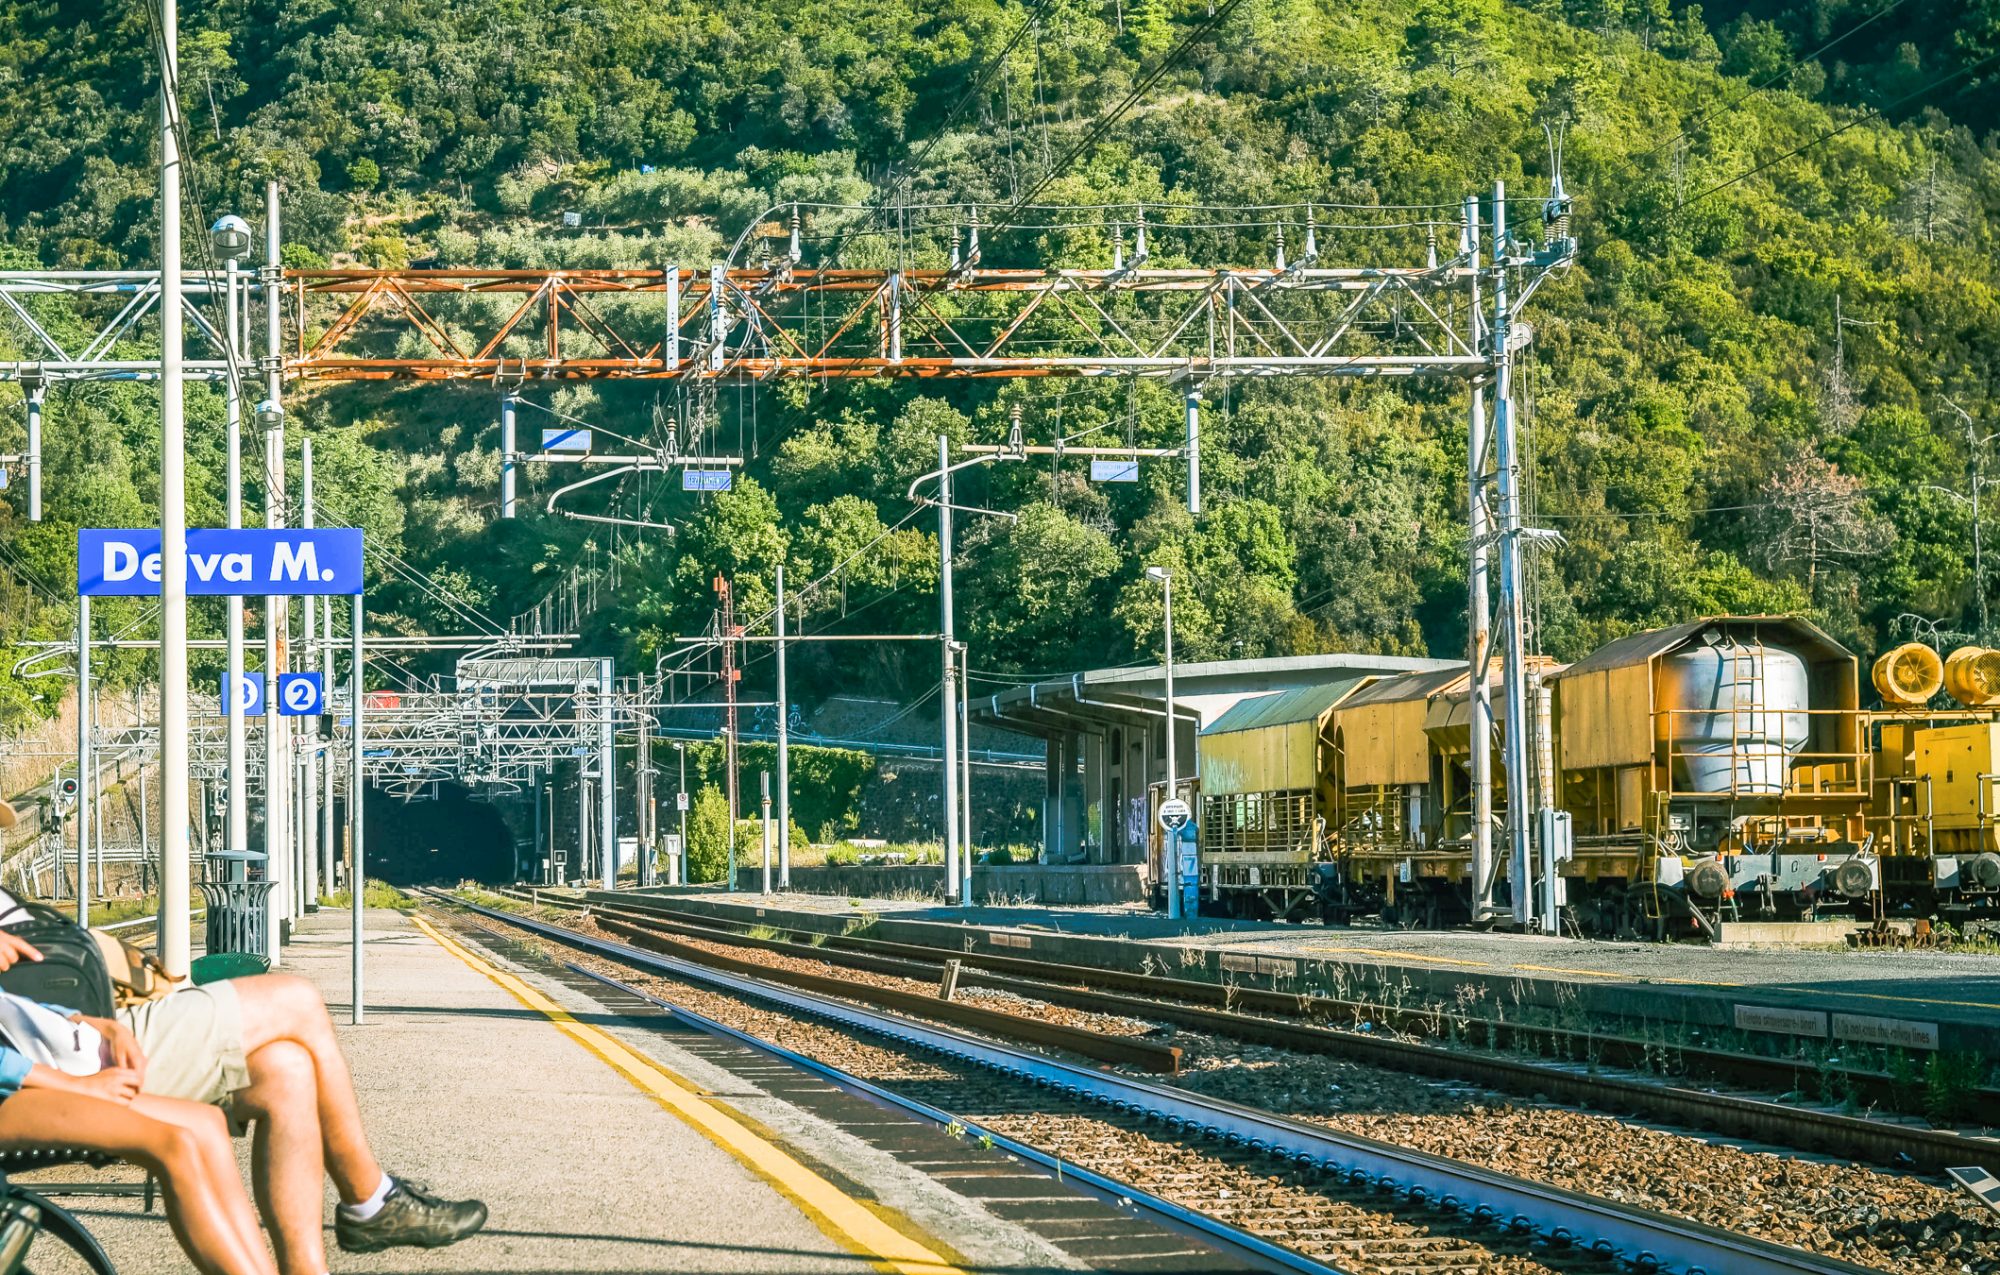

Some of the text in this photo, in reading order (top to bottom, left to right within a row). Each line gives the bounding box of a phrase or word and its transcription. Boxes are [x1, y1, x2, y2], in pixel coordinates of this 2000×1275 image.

[104, 541, 335, 582] Deva M.
[293, 684, 309, 705] 2
